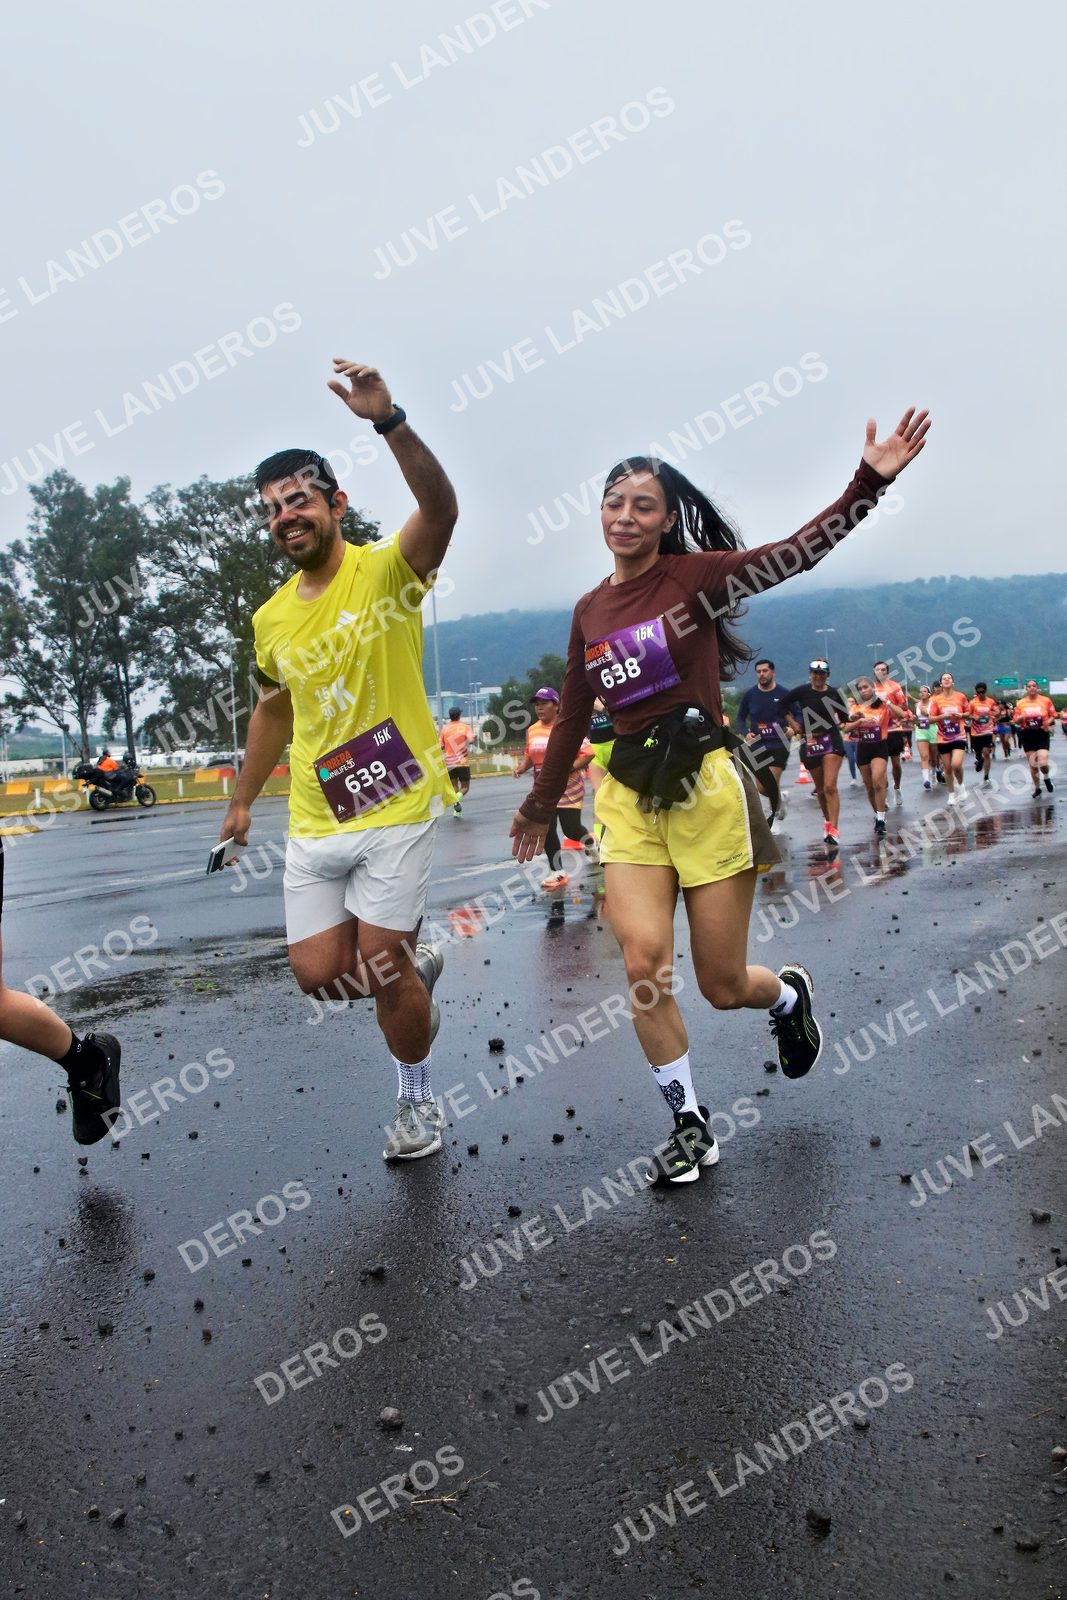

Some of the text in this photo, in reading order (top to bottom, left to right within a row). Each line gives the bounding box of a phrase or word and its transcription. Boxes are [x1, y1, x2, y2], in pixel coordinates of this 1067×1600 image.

[635, 624, 655, 642] 15K
[600, 657, 641, 689] 638
[373, 727, 392, 746] 15K
[344, 760, 387, 793] 639
